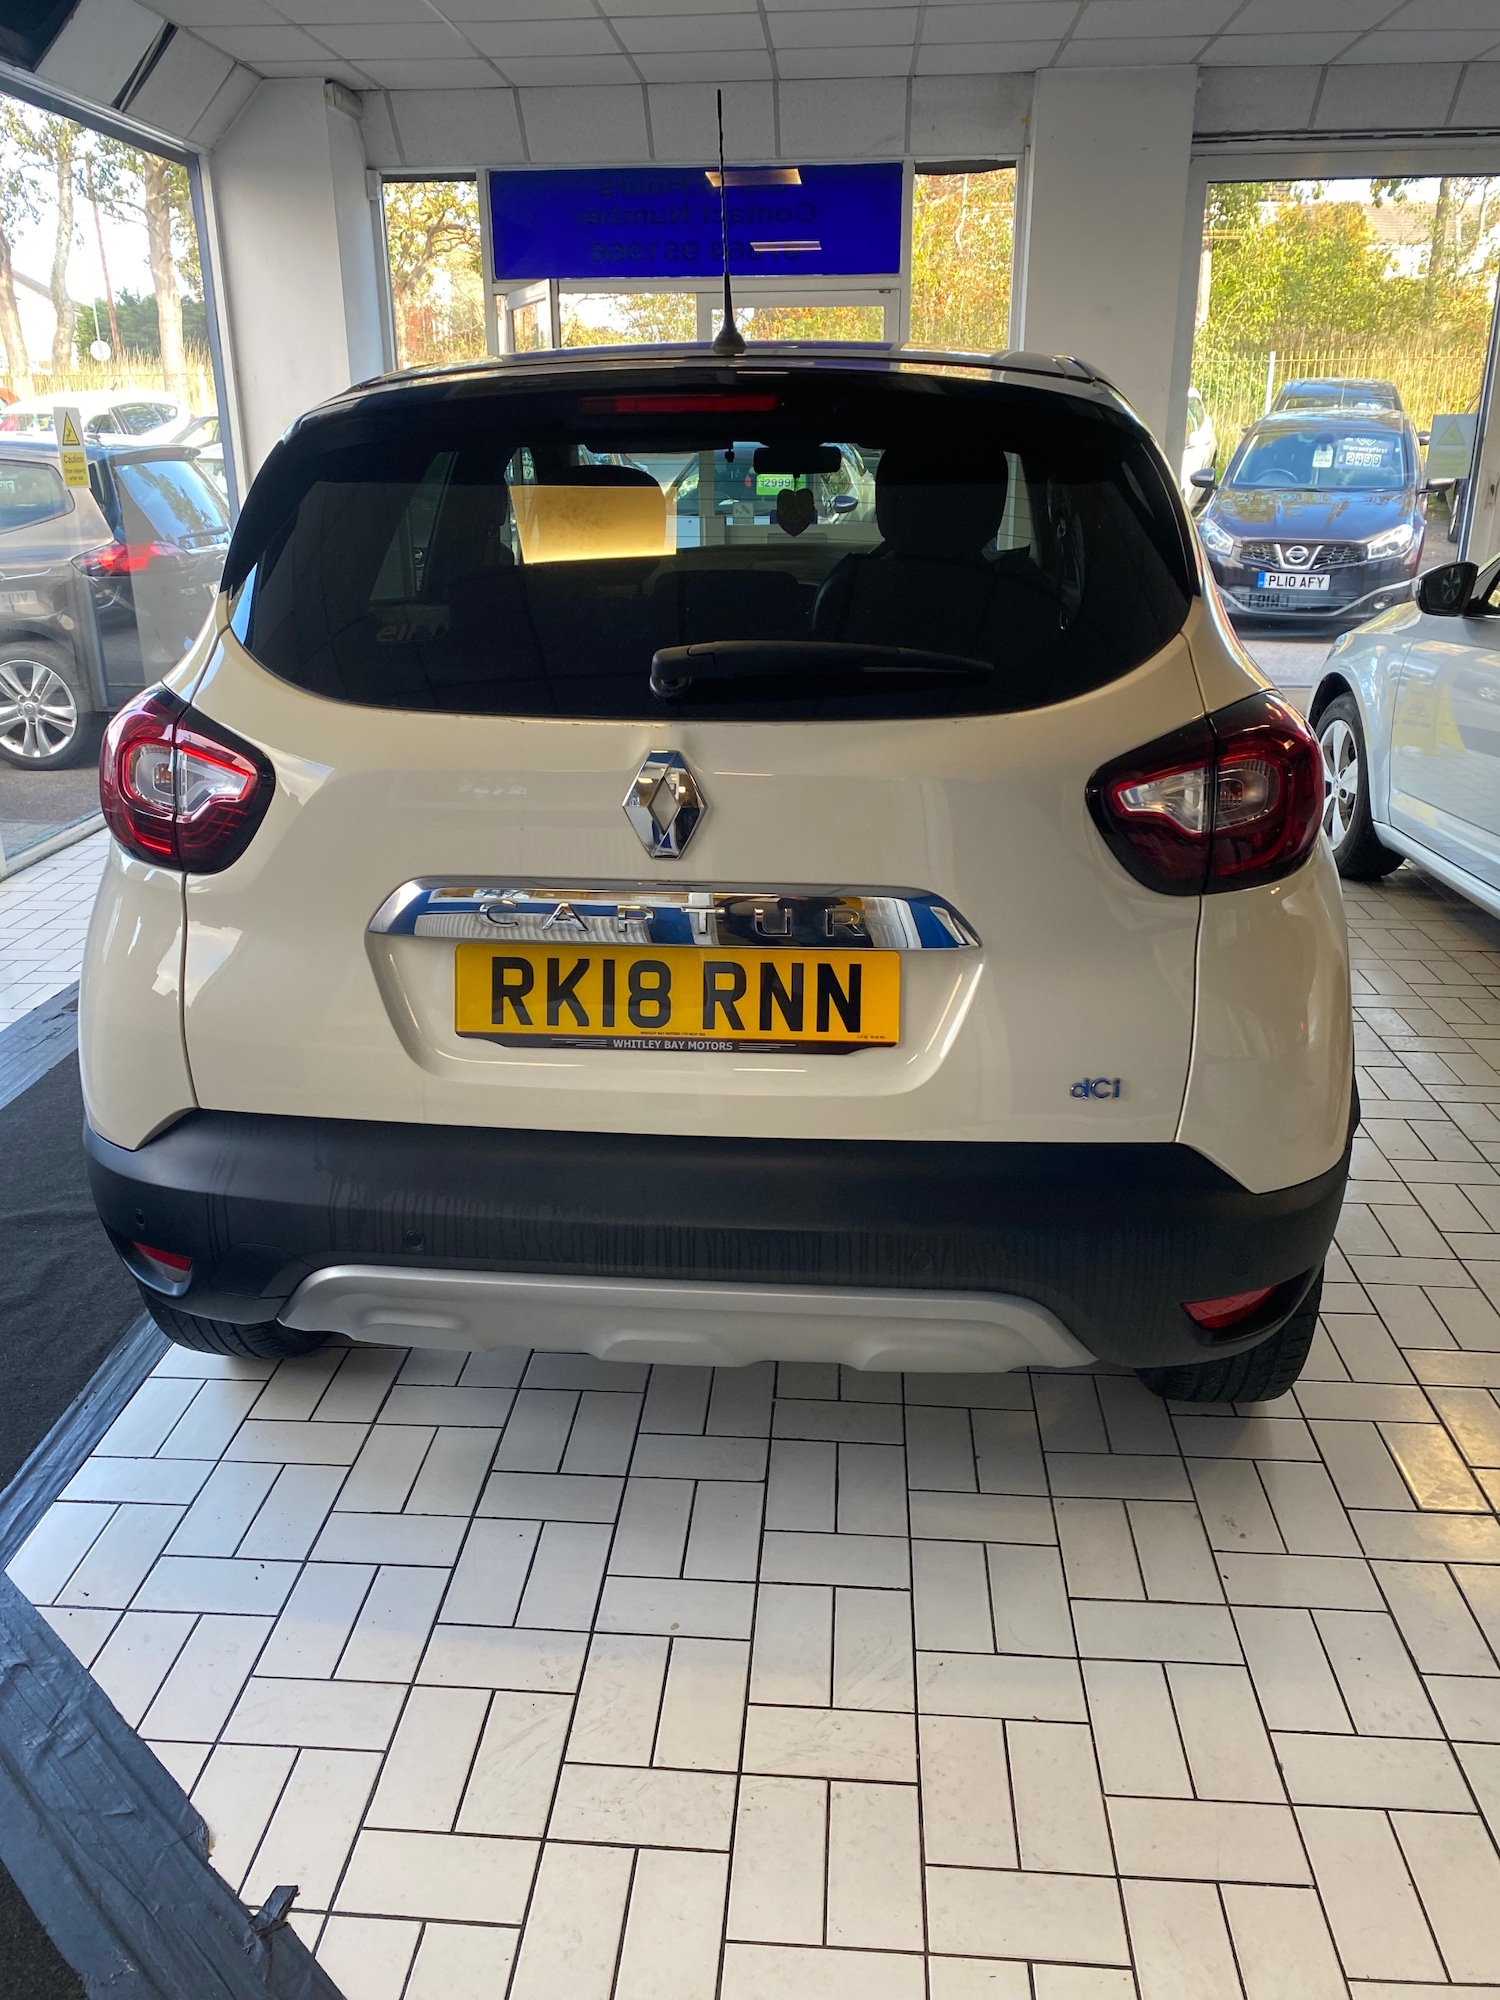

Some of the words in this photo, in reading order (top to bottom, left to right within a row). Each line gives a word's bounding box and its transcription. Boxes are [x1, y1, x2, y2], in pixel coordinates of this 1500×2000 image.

[1268, 575, 1296, 587] PL10
[1299, 576, 1325, 588] AFY
[478, 901, 866, 937] CAPTUR
[490, 956, 672, 1029] RK18
[702, 960, 862, 1033] RNN
[613, 1039, 661, 1048] WHITLEY
[664, 1040, 685, 1050] BAY
[688, 1041, 733, 1050] MOTORS
[1069, 1077, 1121, 1100] dCi
